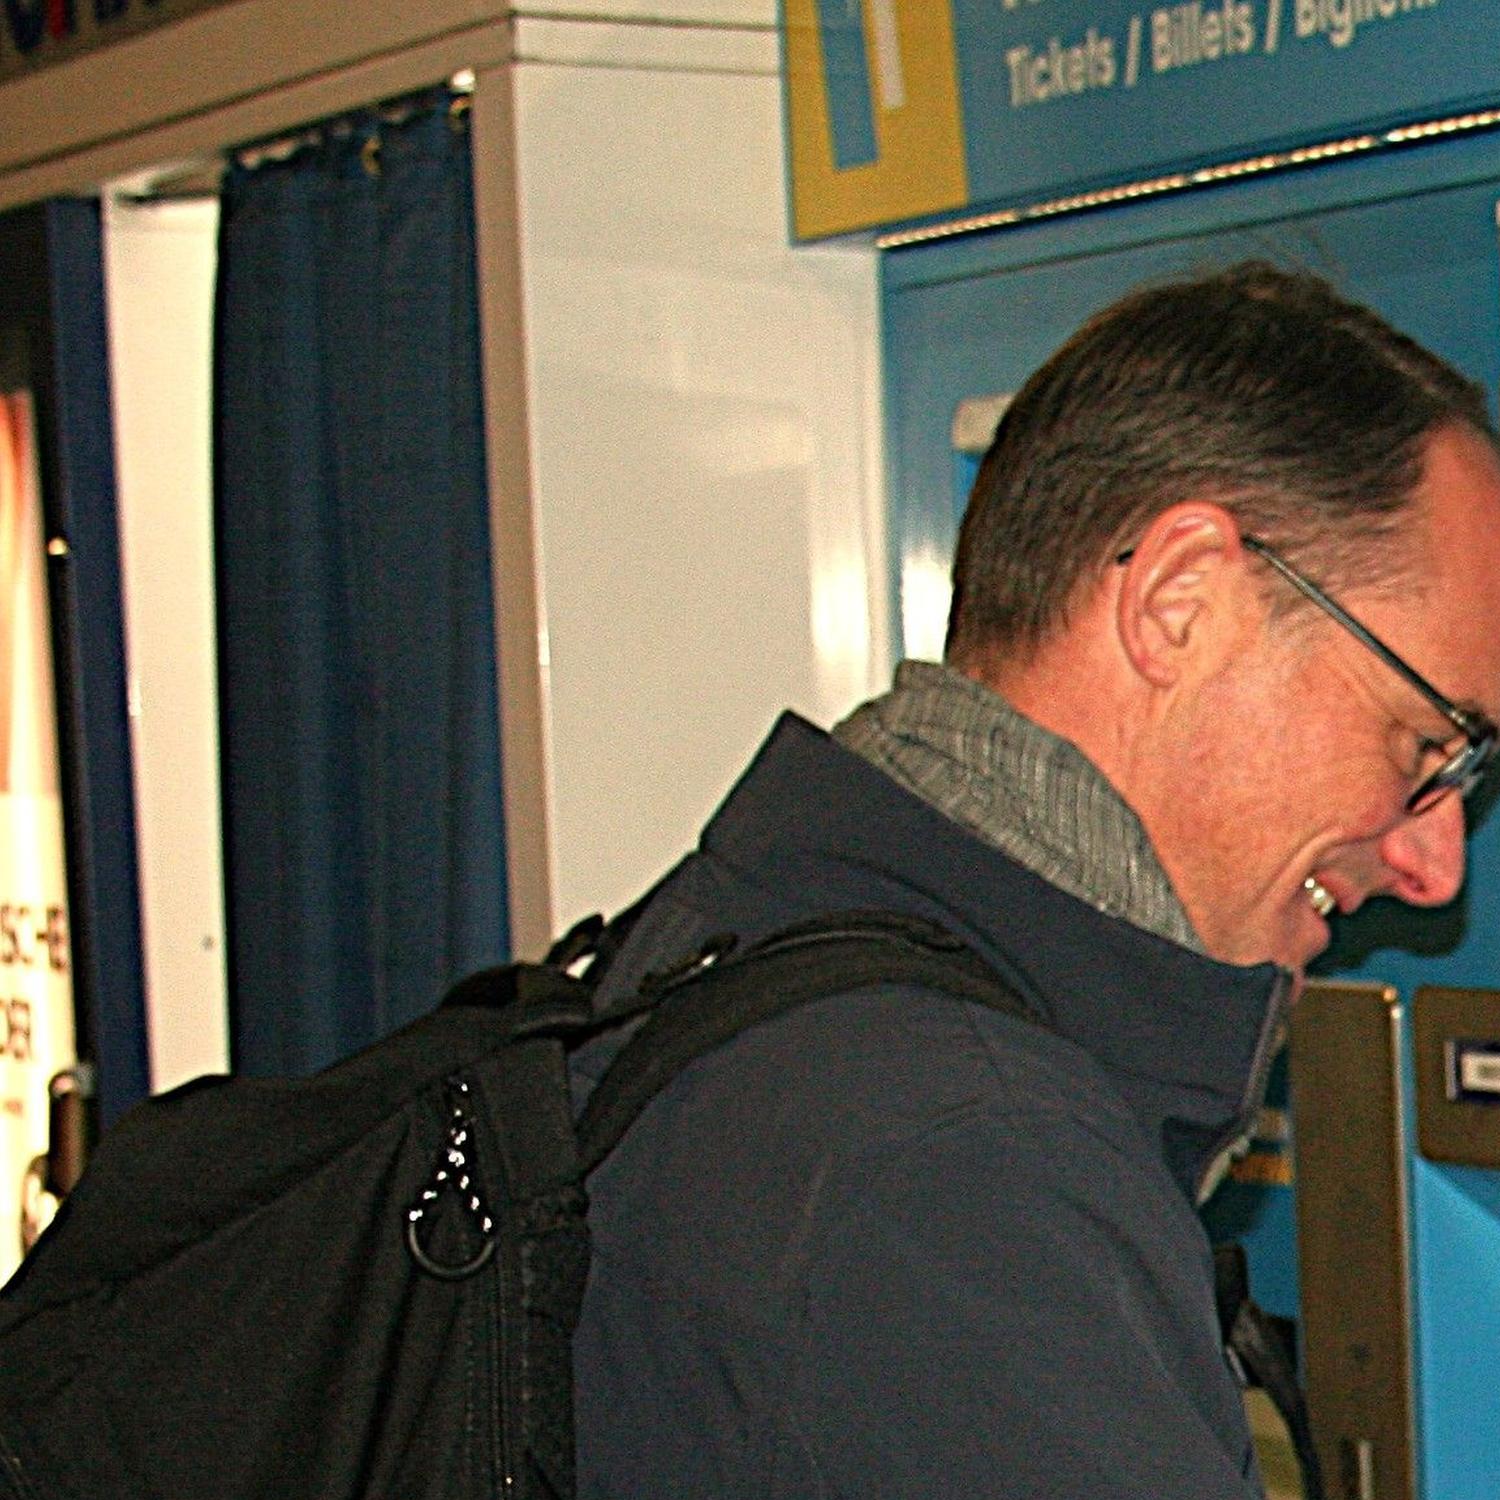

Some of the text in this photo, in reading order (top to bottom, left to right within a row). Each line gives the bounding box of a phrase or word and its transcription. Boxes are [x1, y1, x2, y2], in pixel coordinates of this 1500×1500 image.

[1005, 27, 1116, 106] Tickets
[1124, 14, 1142, 87] /
[1151, 0, 1254, 72] Billets
